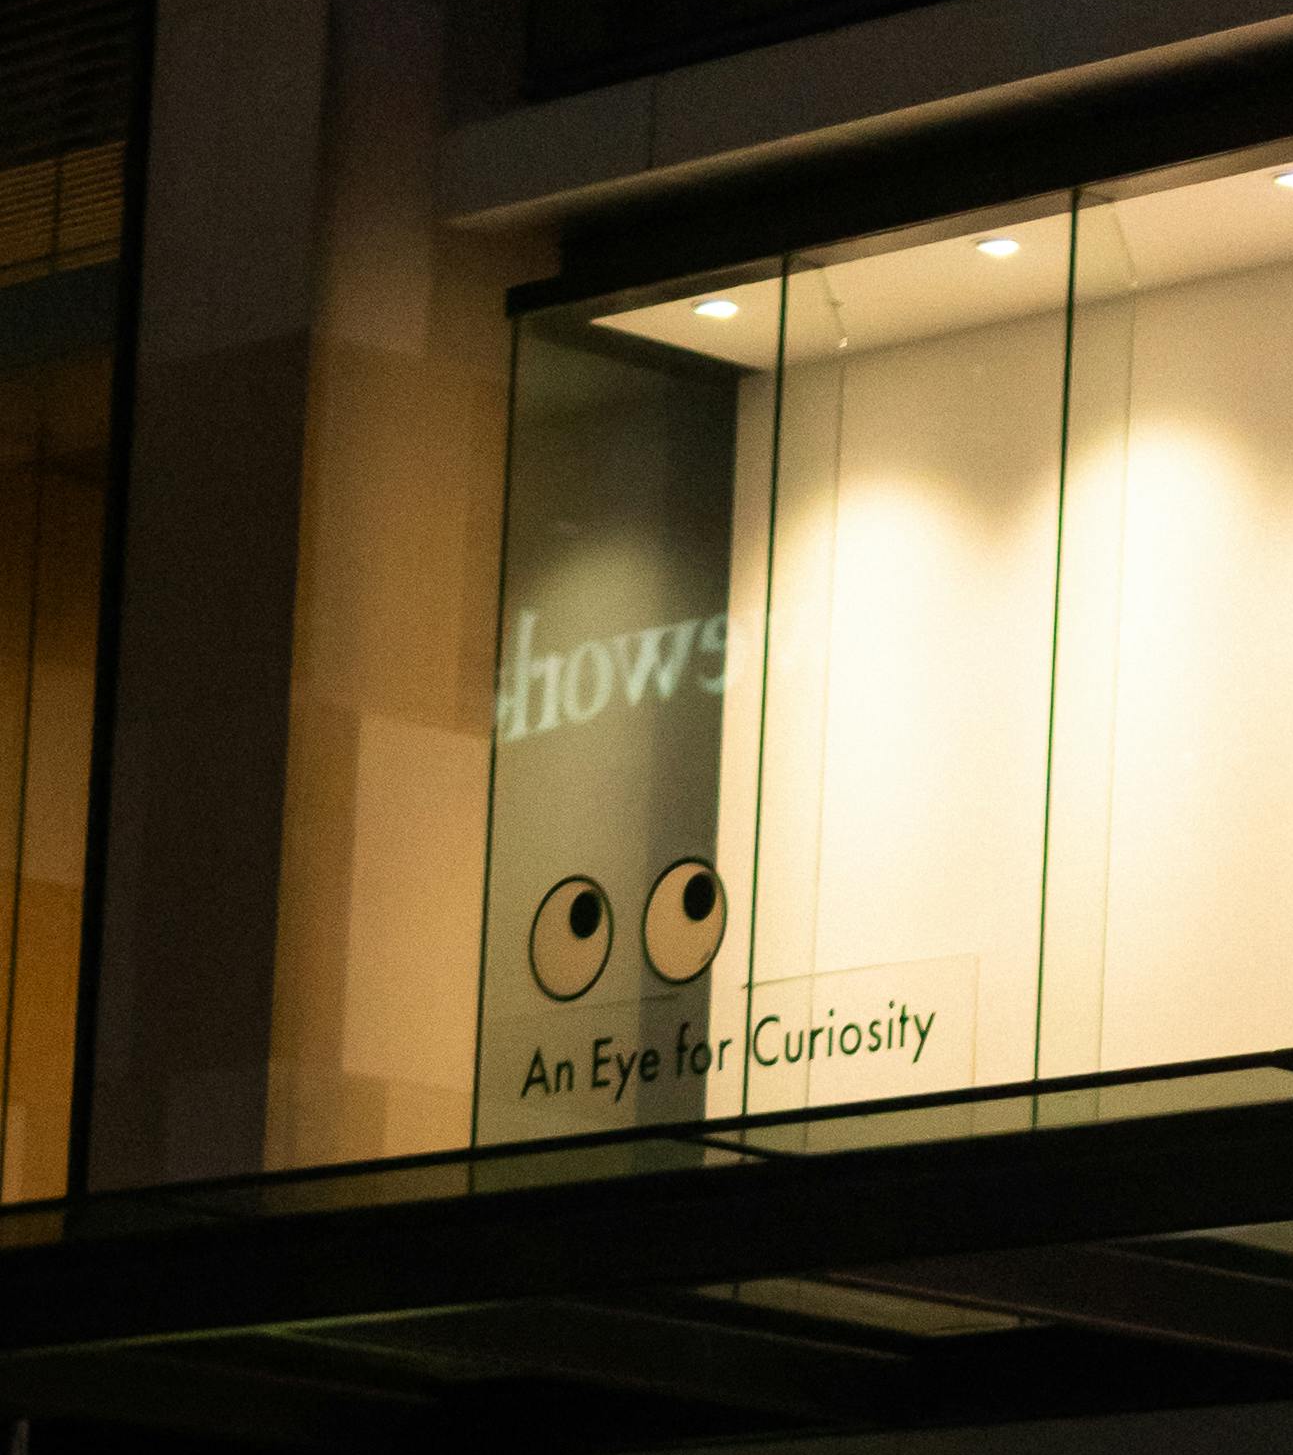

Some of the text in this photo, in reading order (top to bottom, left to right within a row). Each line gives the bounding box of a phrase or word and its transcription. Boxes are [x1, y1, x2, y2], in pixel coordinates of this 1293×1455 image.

[520, 1000, 936, 1102] An Eye for Curiosity
